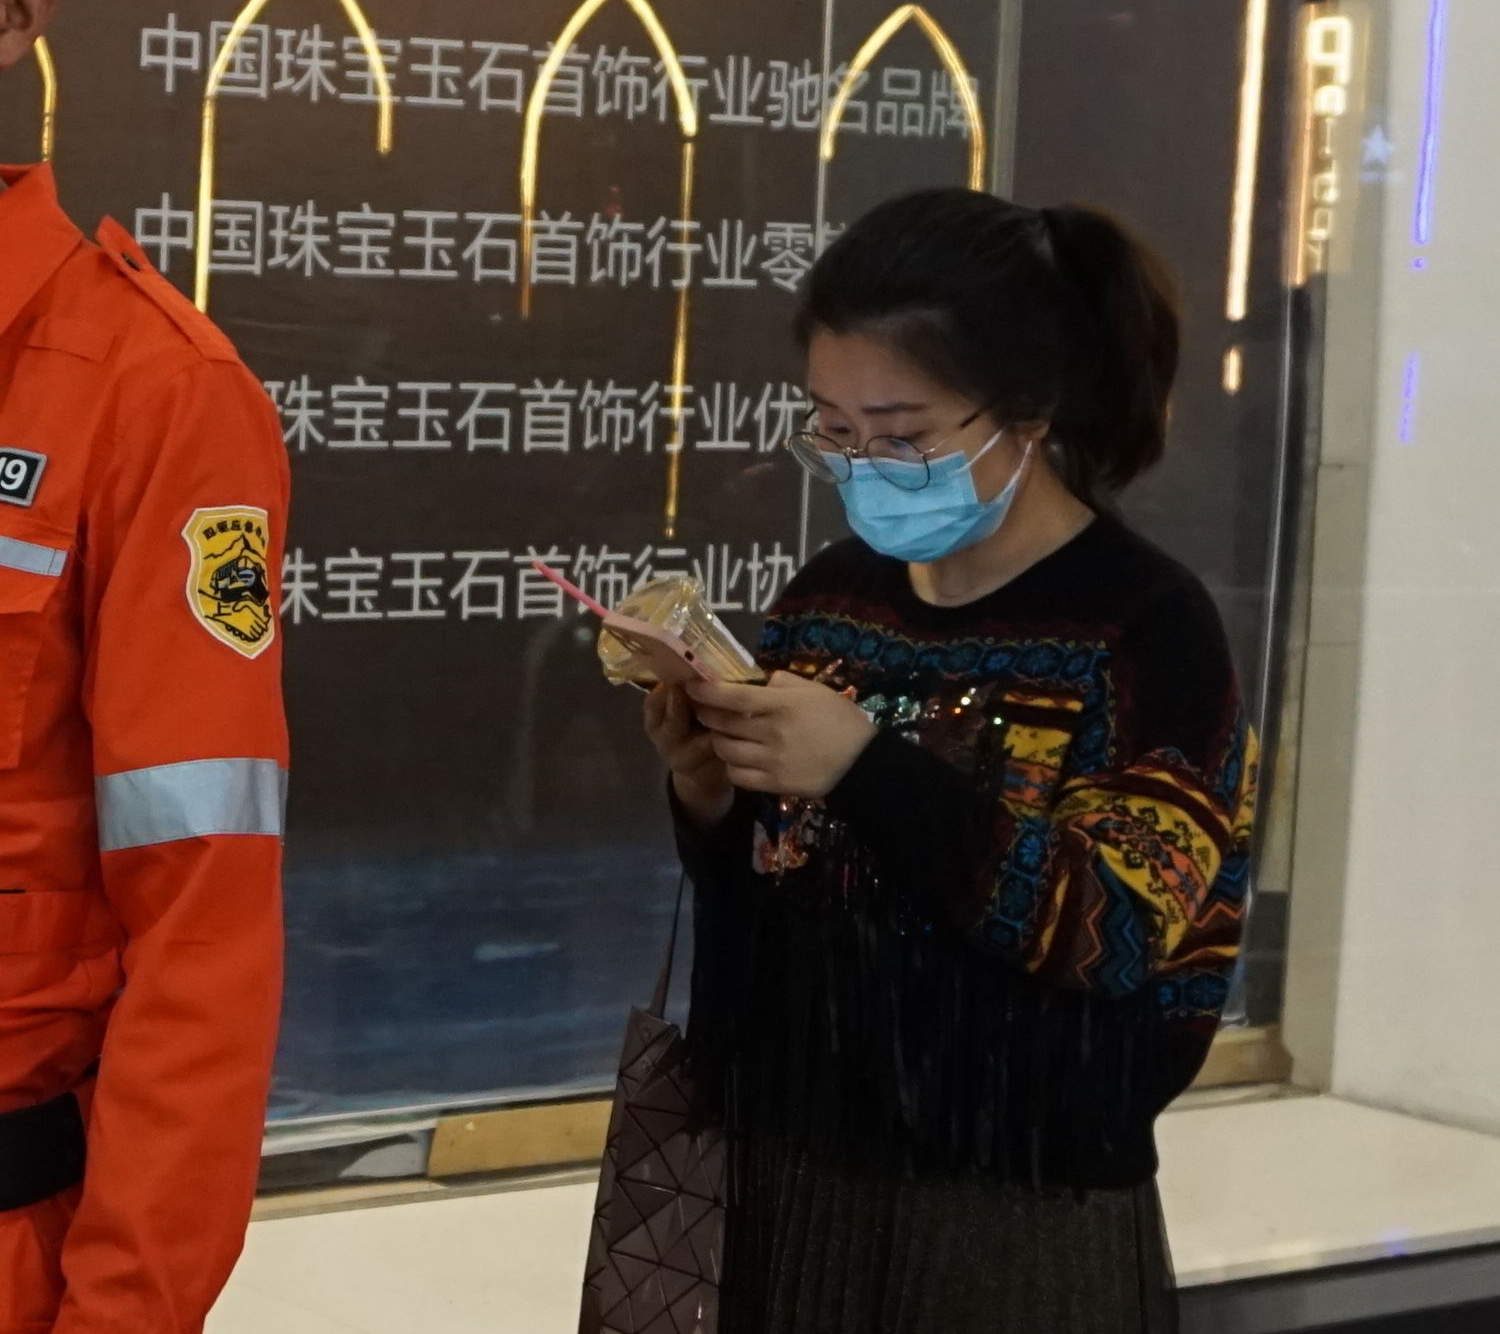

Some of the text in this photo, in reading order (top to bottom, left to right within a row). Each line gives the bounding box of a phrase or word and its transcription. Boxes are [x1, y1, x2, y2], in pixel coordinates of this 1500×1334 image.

[139, 11, 979, 139] 中国珠宝玉石首饰行业驰名品牌
[134, 191, 849, 294] 中国珠宝玉石首饰行业零
